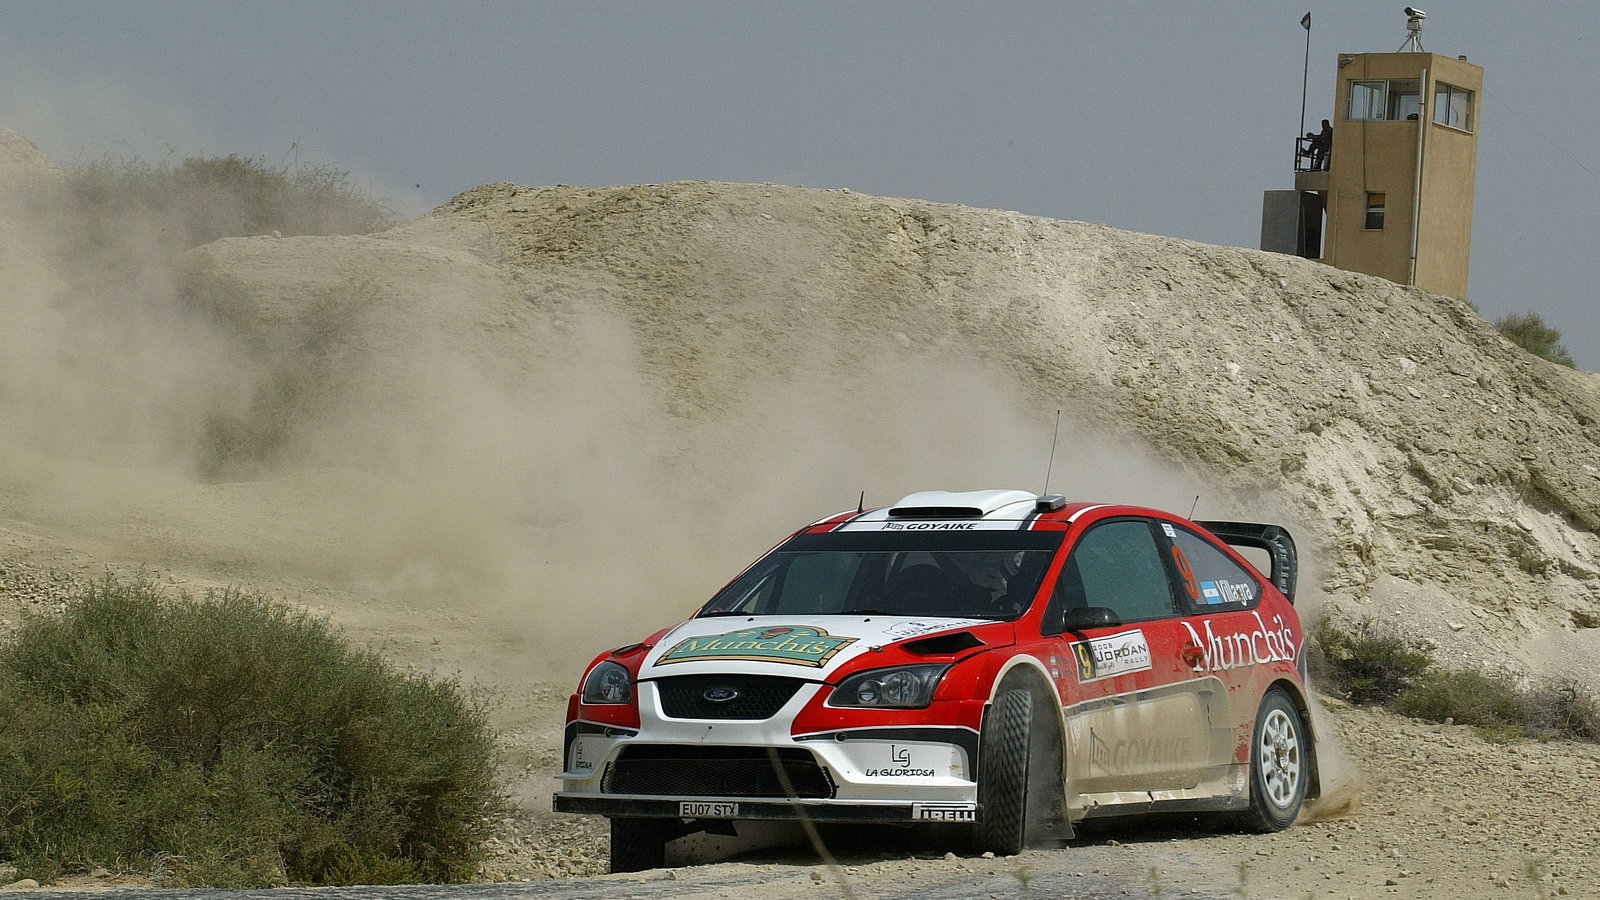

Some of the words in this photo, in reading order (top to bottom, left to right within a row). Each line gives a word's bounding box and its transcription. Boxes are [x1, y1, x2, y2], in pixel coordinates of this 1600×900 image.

[1171, 545, 1199, 600] 9
[1214, 579, 1254, 606] Villagra
[1180, 610, 1296, 672] Munchi's
[1077, 643, 1092, 679] 9
[1096, 643, 1148, 663] JORDAN
[1124, 655, 1149, 666] RALLY
[865, 768, 878, 777] LA
[880, 768, 936, 777] GLORIOSA
[682, 803, 711, 816] EU07
[714, 804, 737, 816] STX
[911, 801, 977, 821] PIRELLI
